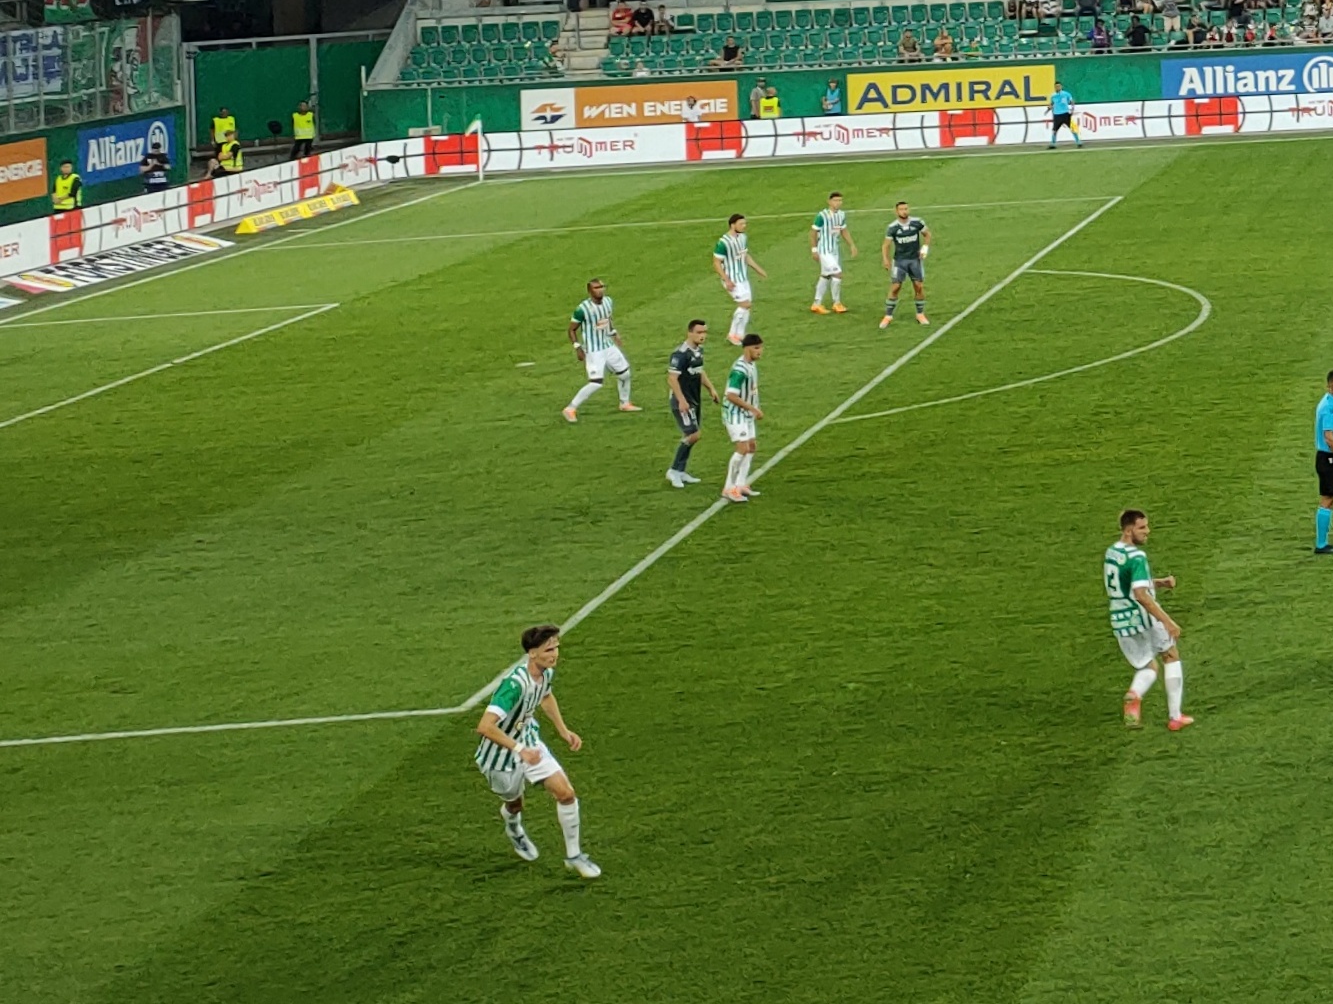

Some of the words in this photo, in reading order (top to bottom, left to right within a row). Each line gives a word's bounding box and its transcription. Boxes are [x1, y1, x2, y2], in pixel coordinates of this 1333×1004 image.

[855, 75, 1047, 110] ADMIRAL
[1178, 64, 1296, 96] Allianz
[583, 102, 637, 121] WIEN
[643, 97, 728, 117] ENEGIE
[86, 135, 146, 173] Allianz
